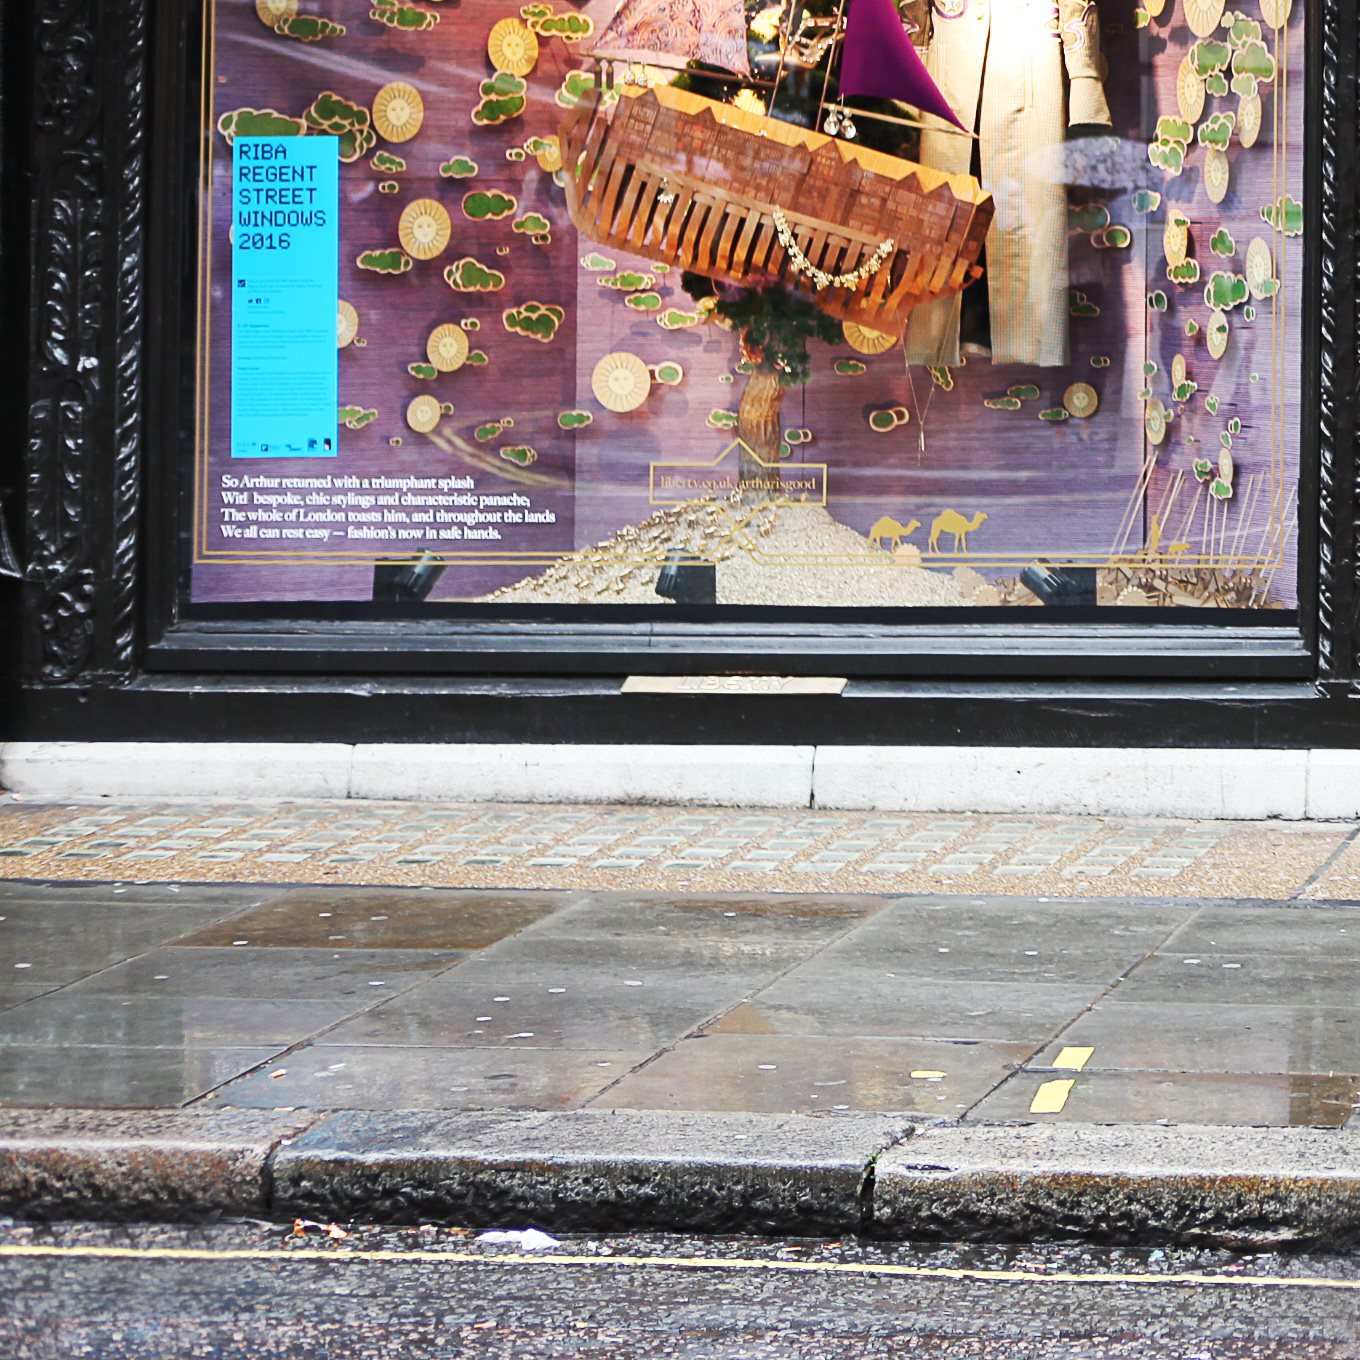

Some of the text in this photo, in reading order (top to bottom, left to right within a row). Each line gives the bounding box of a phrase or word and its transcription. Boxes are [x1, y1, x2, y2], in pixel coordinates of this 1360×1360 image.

[239, 143, 287, 160] RIBA
[239, 165, 318, 183] REGENT
[239, 187, 318, 205] STREET
[239, 210, 327, 227] WINDOWS
[239, 232, 291, 250] 2016
[221, 475, 475, 492] So Arthur returned with a triumphant splash
[253, 492, 305, 507] bespoke,
[305, 492, 331, 505] chic
[331, 492, 376, 509] stylings
[377, 492, 400, 505] and
[401, 493, 478, 506] characteristic
[221, 508, 556, 526] The whole of London toasts him, and throughout the lands
[220, 525, 243, 538] We
[243, 525, 258, 538] all
[258, 529, 281, 538] can
[281, 527, 305, 538] rest
[305, 529, 331, 542] easy
[347, 526, 397, 539] fashion's
[398, 528, 424, 539] now
[425, 526, 437, 539] in
[438, 526, 462, 539] safe
[463, 526, 502, 540] hands.
